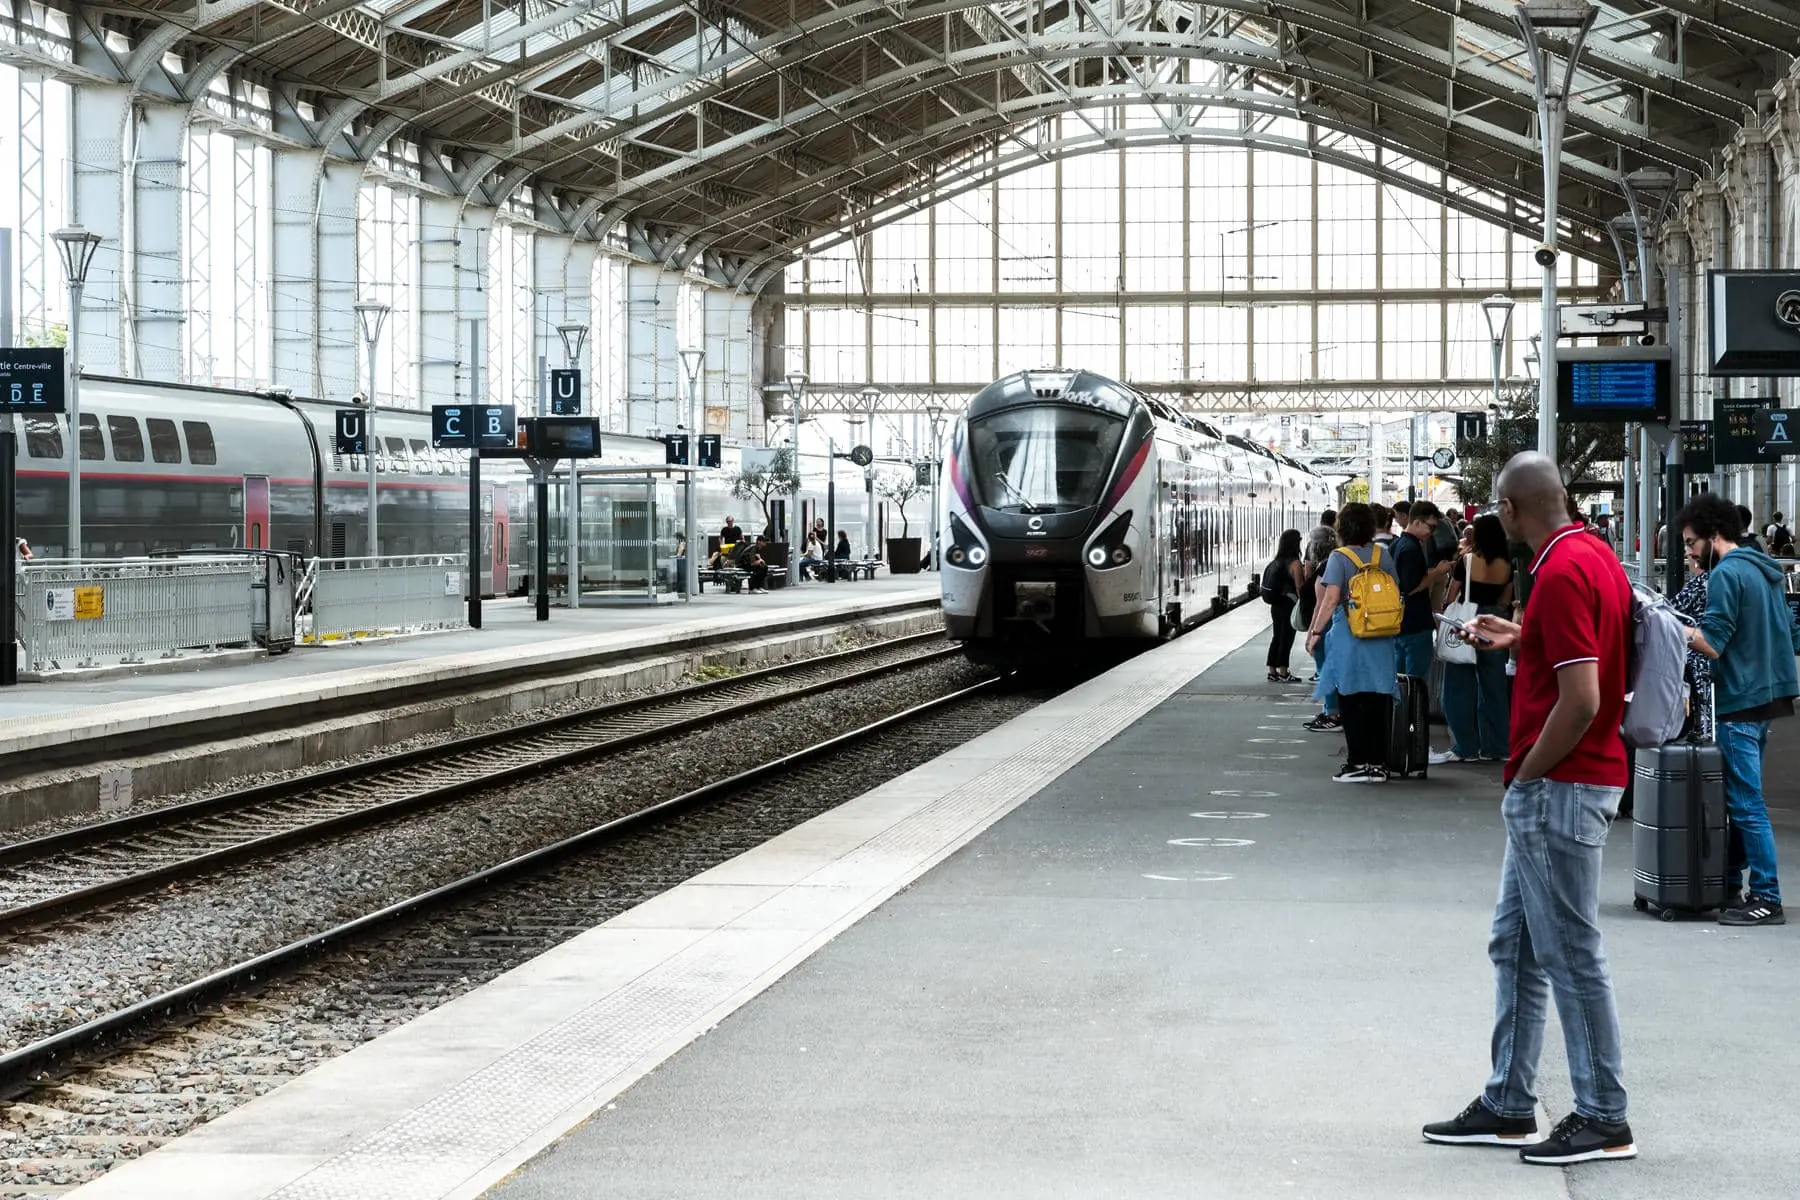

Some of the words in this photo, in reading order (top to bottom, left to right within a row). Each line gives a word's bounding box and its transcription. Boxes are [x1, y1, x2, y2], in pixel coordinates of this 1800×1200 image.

[13, 362, 52, 370] Centre-ville
[11, 389, 22, 401] D
[33, 389, 42, 401] E
[558, 377, 574, 398] U
[343, 417, 359, 438] U
[446, 416, 460, 434] C
[488, 416, 501, 434] B
[1463, 420, 1480, 441] U
[1771, 422, 1788, 440] A
[671, 440, 683, 456] T
[703, 440, 715, 456] T
